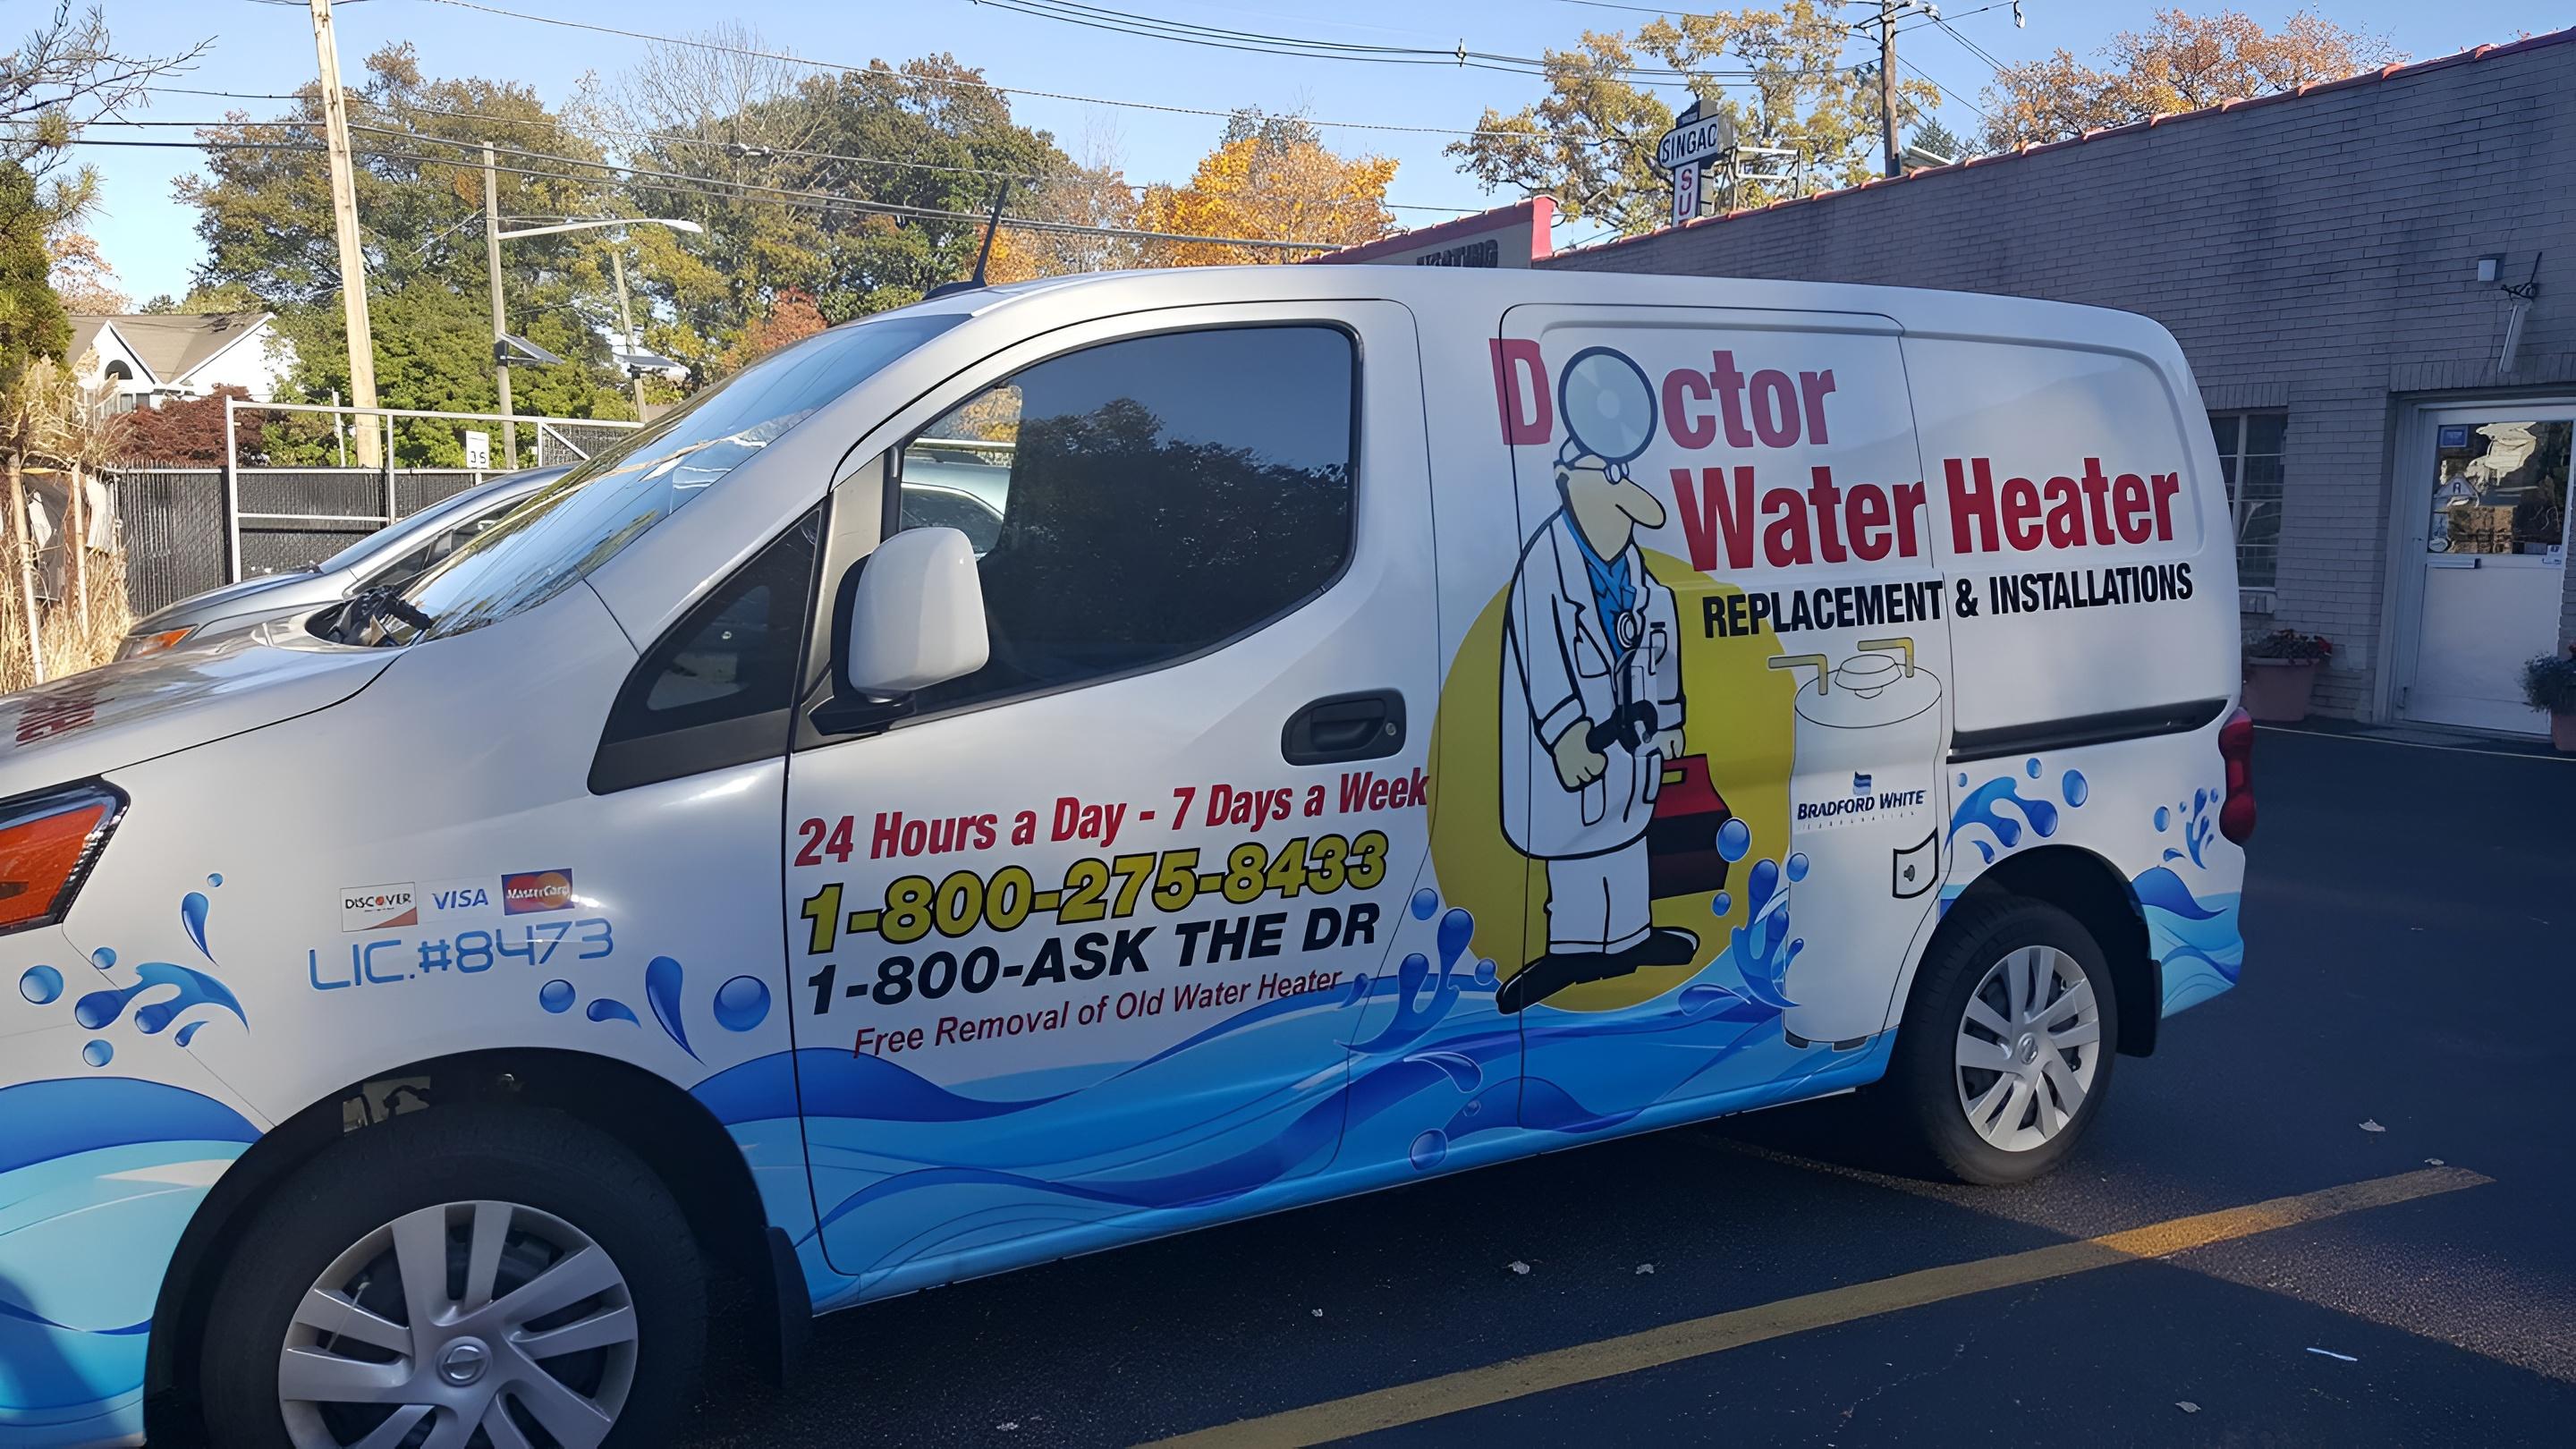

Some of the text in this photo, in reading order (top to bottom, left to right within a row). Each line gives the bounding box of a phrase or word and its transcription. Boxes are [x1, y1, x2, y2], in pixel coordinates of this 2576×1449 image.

[1661, 123, 1717, 164] SINGAC
[1678, 168, 1693, 224] SU
[1670, 457, 2180, 572] Water Heater
[1702, 562, 2193, 639] REPLACEMENT & INSTALLATIONS
[794, 767, 1430, 868] 24 Hours a Day - 7 Days a Week
[1797, 790, 1927, 820] BRADFORD WHITE
[345, 893, 411, 910] DISCOVER
[432, 888, 489, 910] VISA
[801, 829, 1389, 955] 1-800-275-8433
[808, 902, 1380, 1015] 1-800-ASK THE DR
[853, 969, 1343, 1059] Free Removal of Old Water Heater
